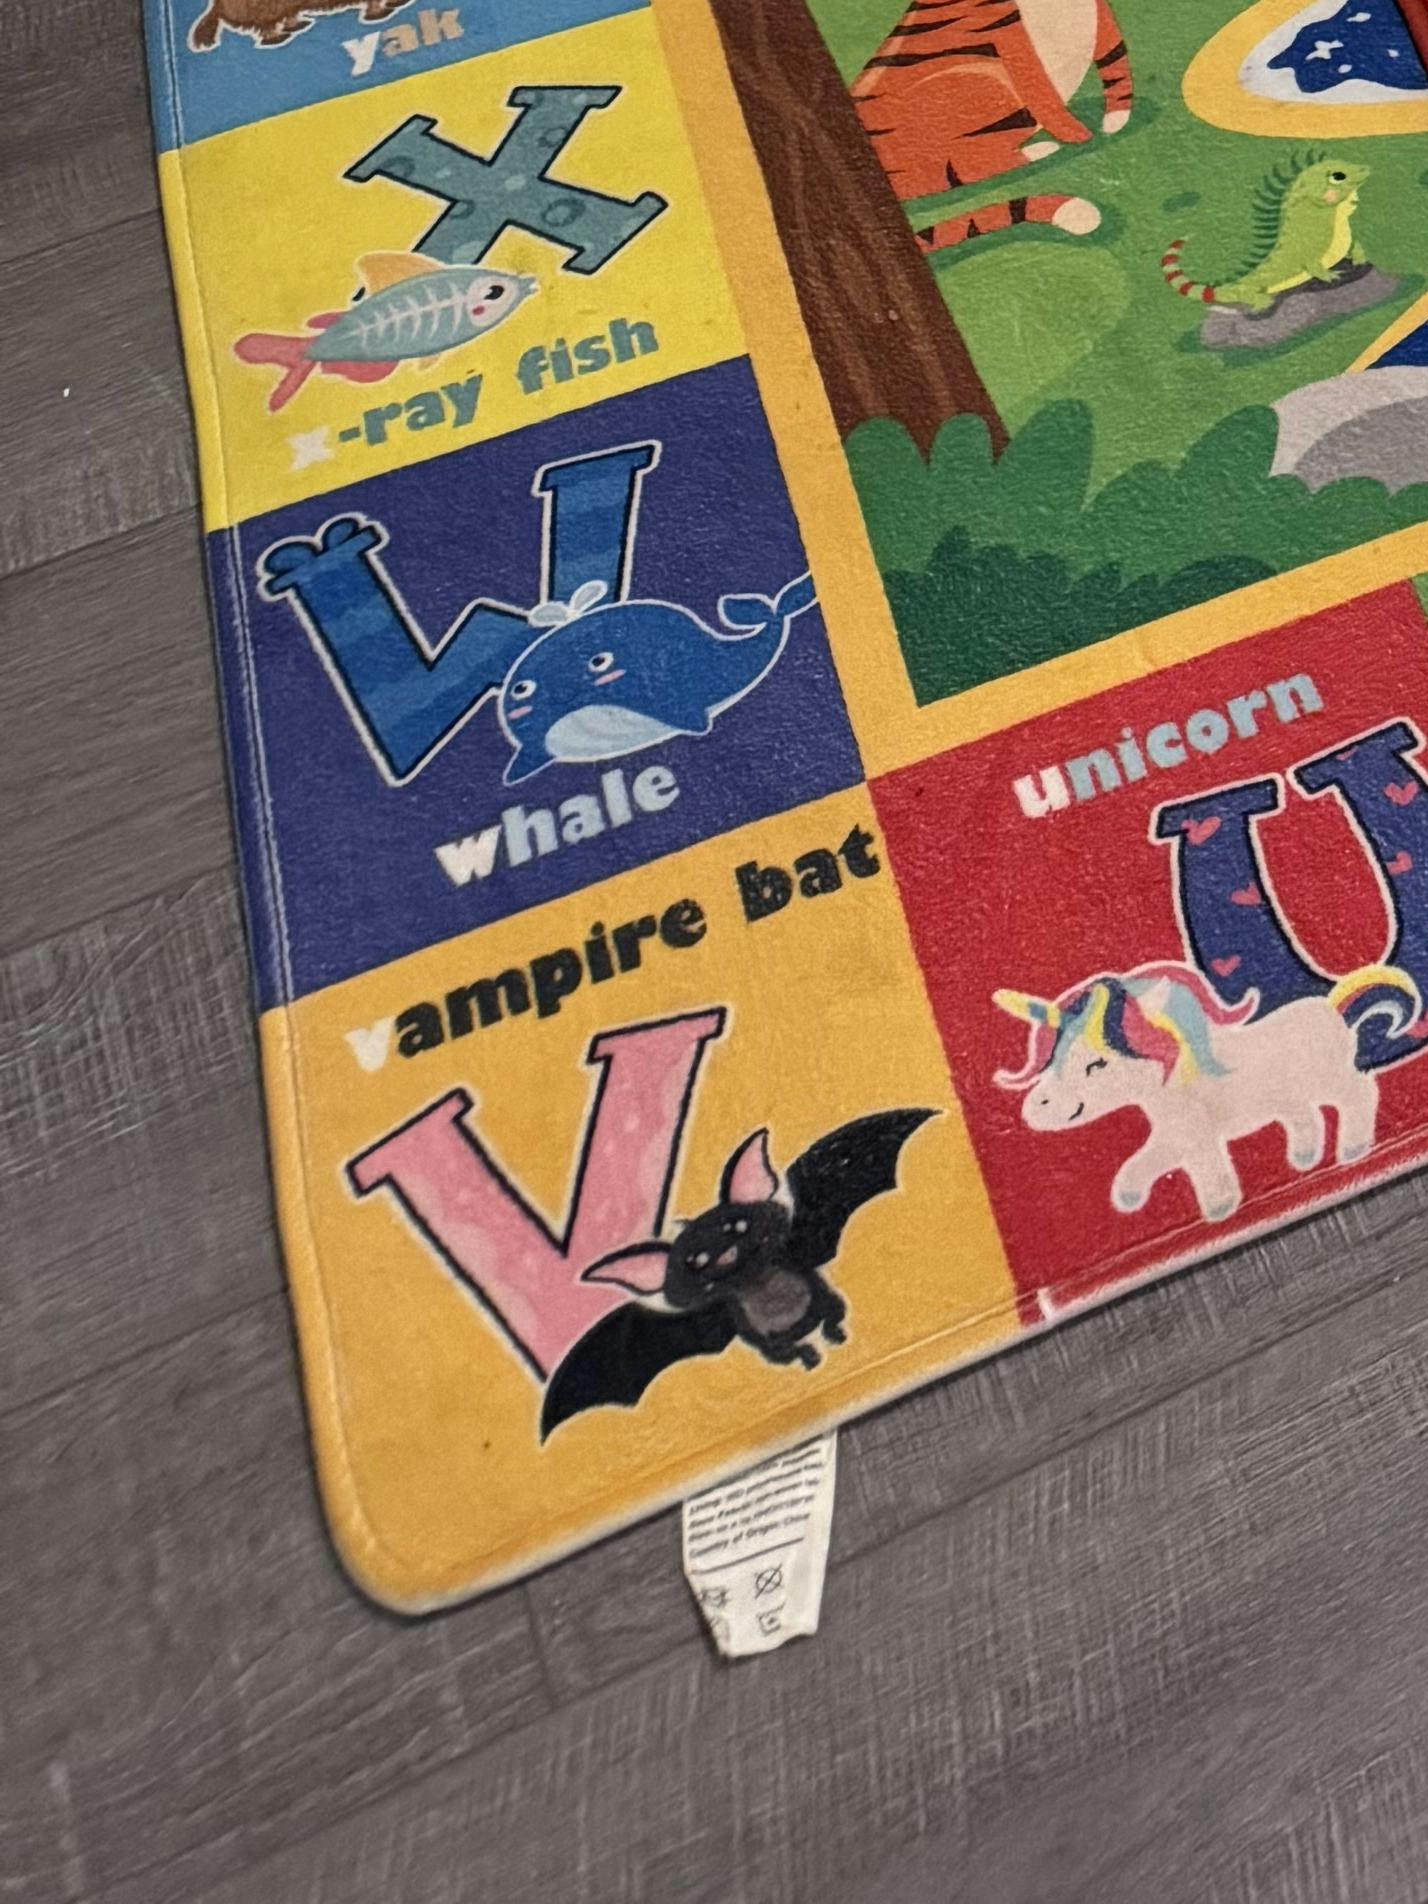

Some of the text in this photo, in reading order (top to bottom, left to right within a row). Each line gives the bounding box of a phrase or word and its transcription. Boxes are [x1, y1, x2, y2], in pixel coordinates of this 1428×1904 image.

[341, 3, 464, 78] yak
[343, 84, 670, 302] X
[286, 316, 658, 473] x-ray fish
[256, 440, 663, 787] W
[434, 761, 680, 888] whale
[1012, 671, 1324, 819] unicorn
[344, 822, 881, 1073] vampire bat
[341, 1003, 731, 1387] V
